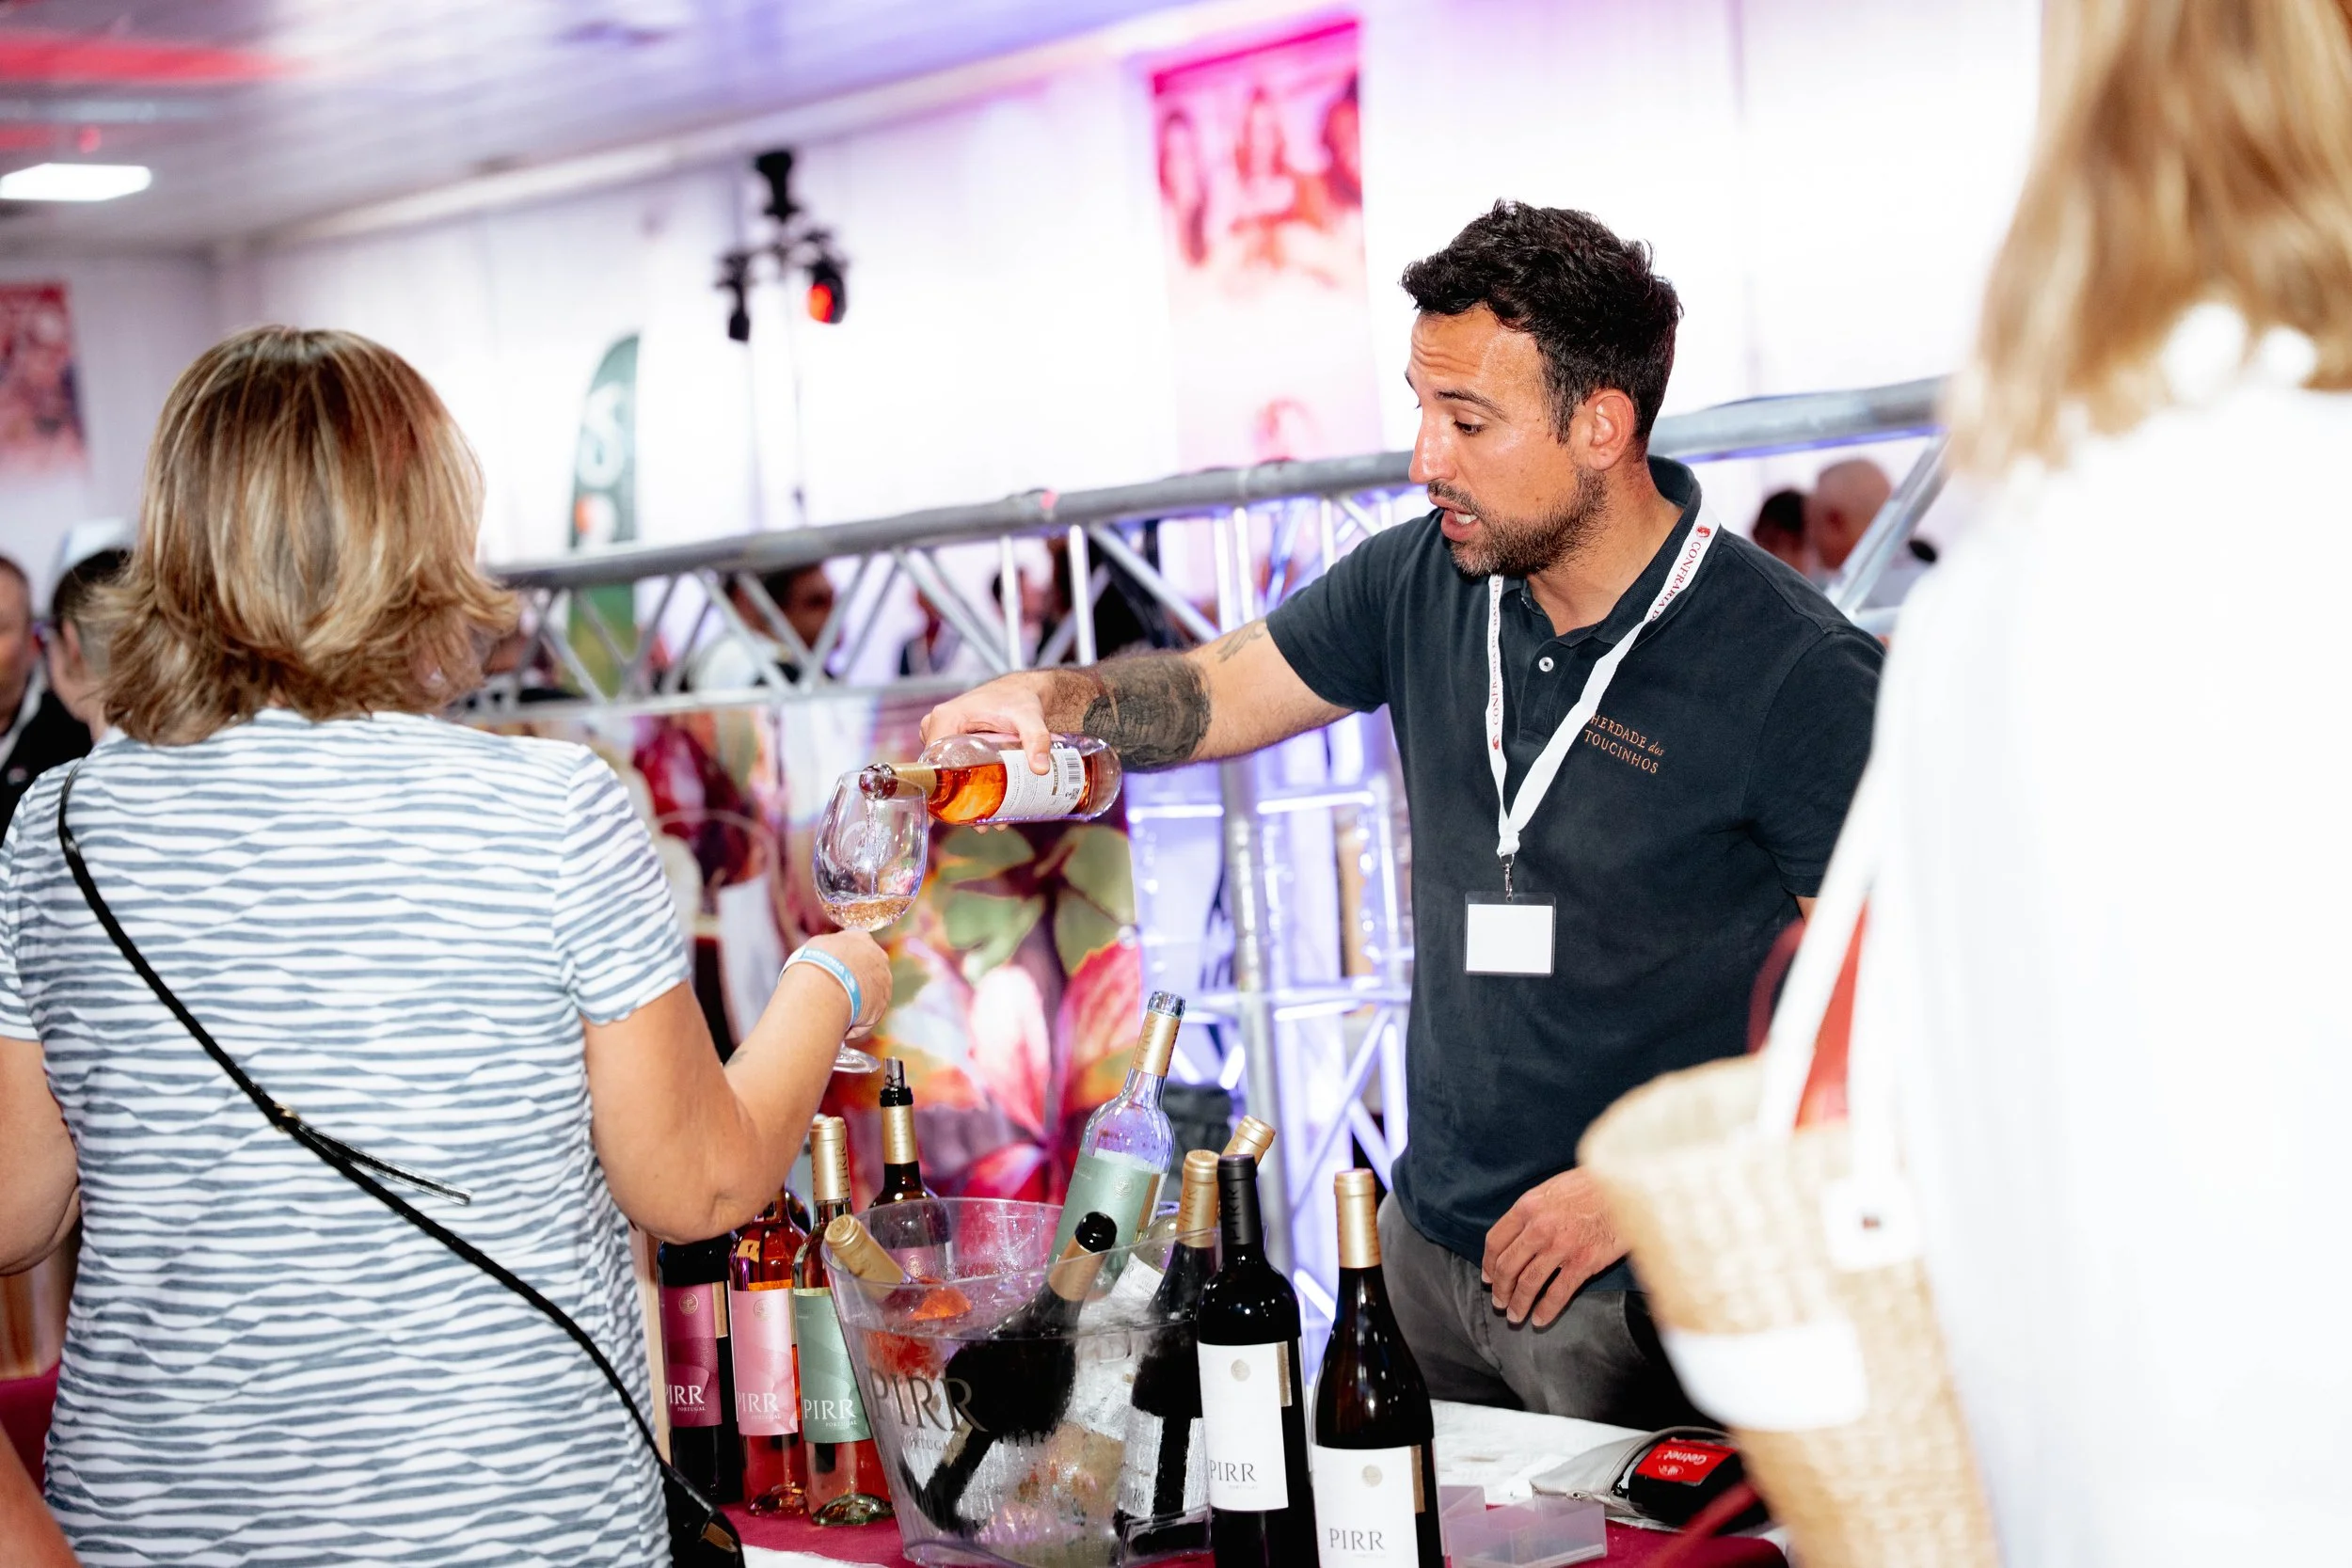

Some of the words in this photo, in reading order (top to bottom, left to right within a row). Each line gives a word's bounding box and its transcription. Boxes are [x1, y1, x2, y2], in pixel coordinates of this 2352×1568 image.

[1658, 541, 1702, 608] CONFRARIA
[1584, 729, 1659, 774] TOUCINHOS
[1590, 715, 1647, 749] HERDADE
[1647, 741, 1664, 756] dos
[803, 1398, 857, 1421] PIRR
[867, 1367, 990, 1433] PIRR
[1209, 1459, 1257, 1482] PIRR
[1662, 1449, 1708, 1465] Getnet
[1329, 1528, 1385, 1551] PIRR
